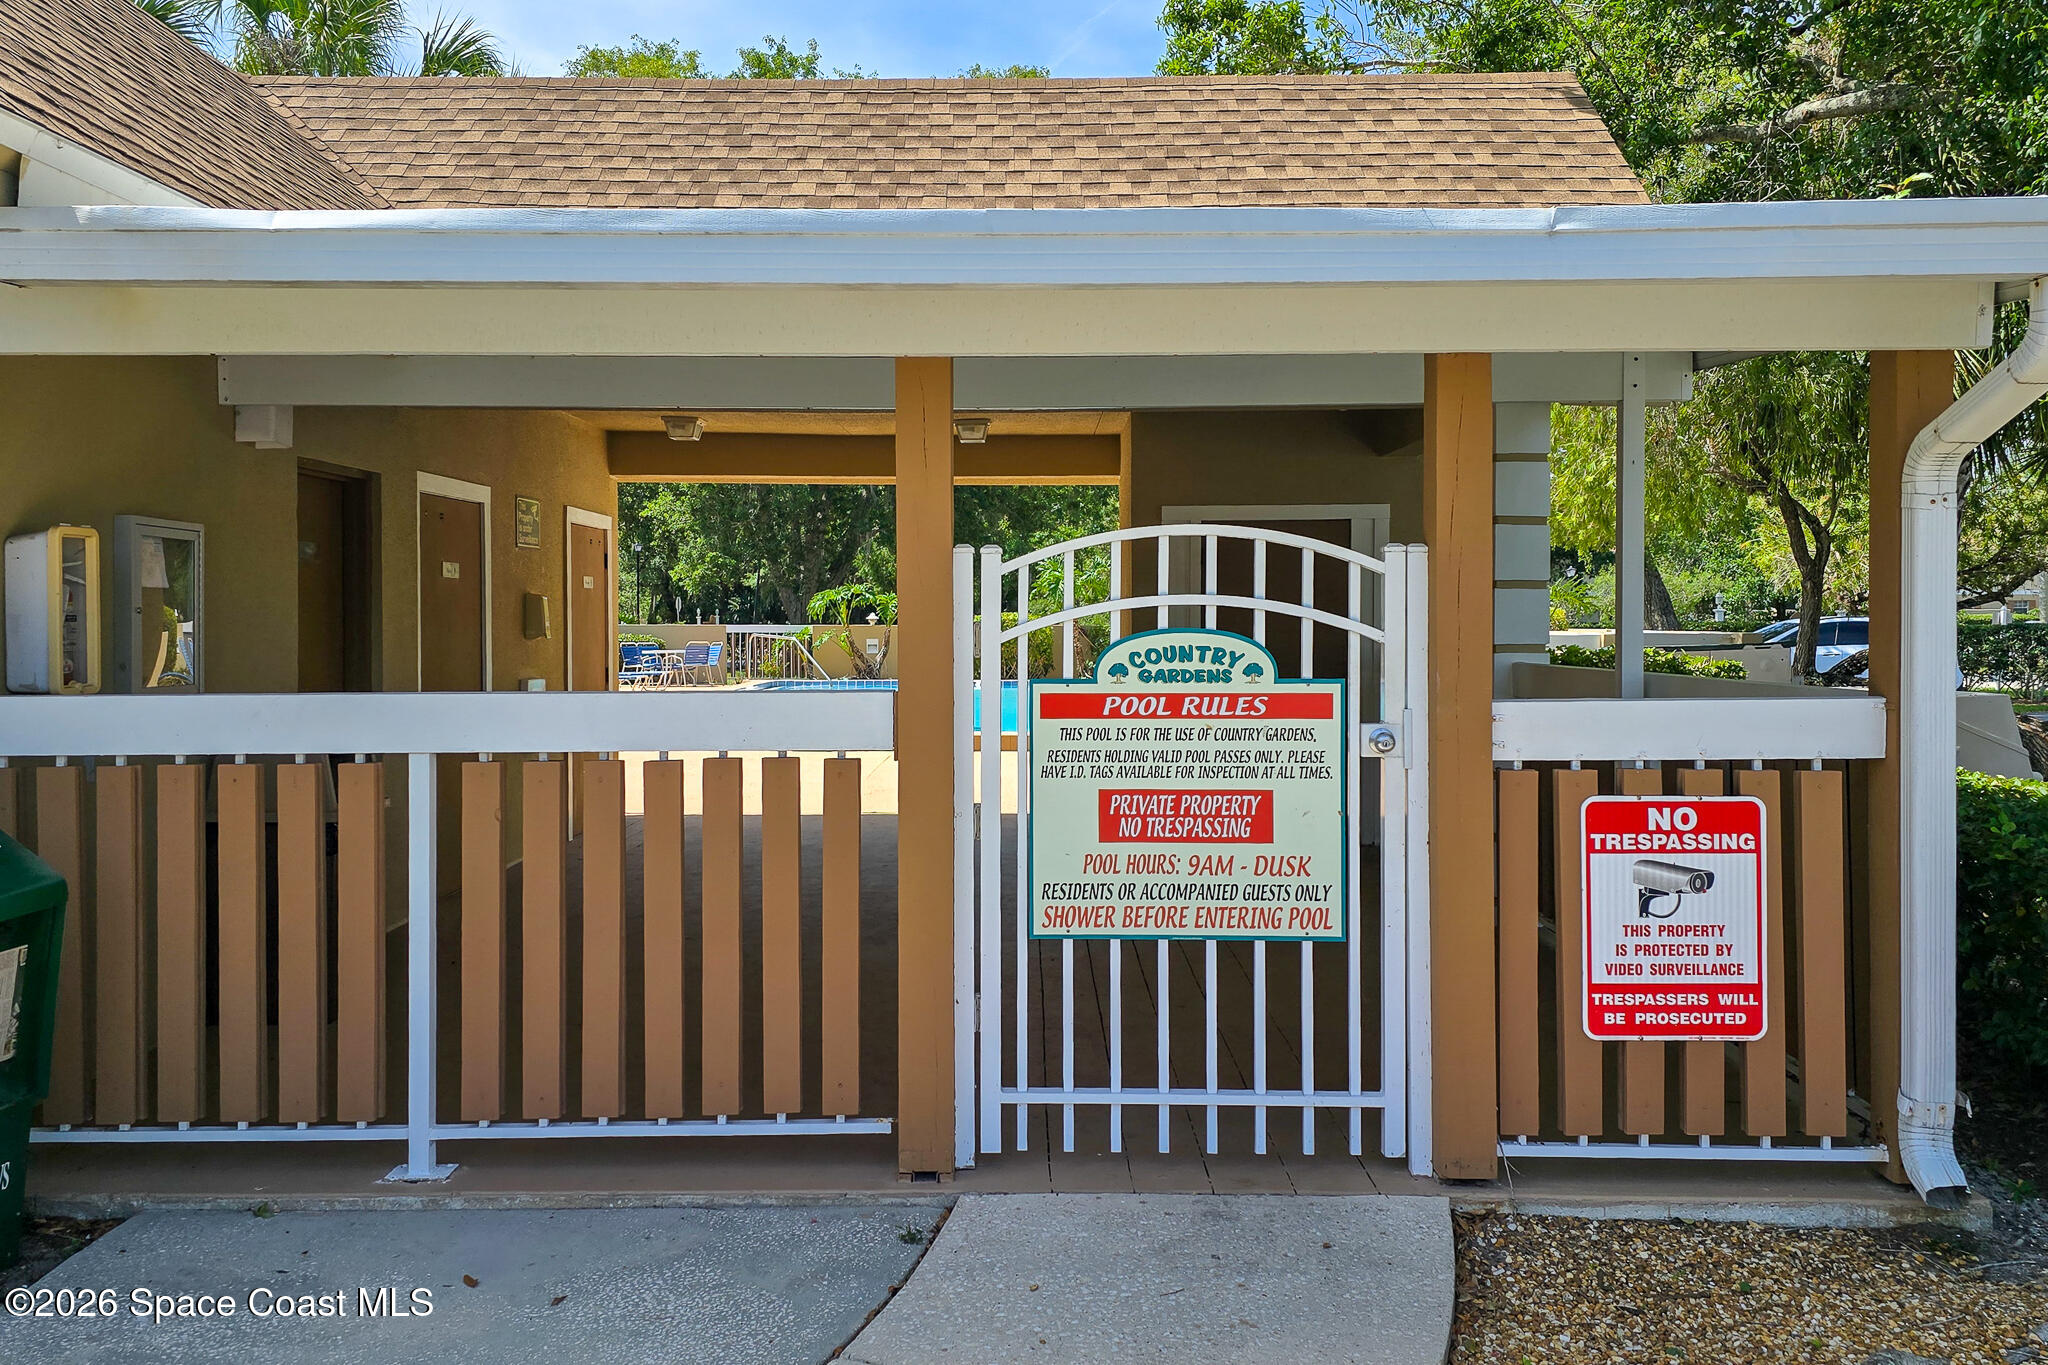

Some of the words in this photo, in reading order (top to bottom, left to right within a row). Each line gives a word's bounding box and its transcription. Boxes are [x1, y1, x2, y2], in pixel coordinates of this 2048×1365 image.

[1129, 645, 1245, 668] COUNTRY
[1138, 669, 1232, 683] GARDENS
[1103, 696, 1172, 716] POOL
[1181, 696, 1269, 716] RULES
[1060, 728, 1083, 741] THIS
[1086, 728, 1112, 741] POOL
[1115, 728, 1127, 741] IS
[1130, 728, 1150, 741] FOR
[1154, 728, 1172, 741] THE
[1175, 728, 1195, 741] USE
[1198, 728, 1211, 741] OF
[1214, 728, 1263, 741] COUNTRY
[1265, 728, 1317, 742] GARDENS.
[1047, 750, 1101, 763] RESIDENTS
[1104, 750, 1149, 763] HOLDING
[1152, 750, 1182, 763] VALID
[1185, 750, 1210, 763] POOL
[1214, 750, 1251, 763] PASSES
[1254, 750, 1284, 763] ONLY.
[1288, 750, 1326, 763] PLEASE
[1041, 765, 1067, 778] HAVE
[1070, 765, 1086, 778] I.D.
[1090, 765, 1114, 778] TAGS
[1116, 765, 1172, 778] AVAILABLE
[1175, 765, 1194, 778] FOR
[1198, 766, 1259, 779] INSPECTION
[1261, 766, 1275, 779] AT
[1277, 766, 1295, 779] ALL
[1299, 766, 1333, 779] TIMES.
[1110, 794, 1176, 815] PRIVATE
[1179, 794, 1261, 816] PROPERTY
[1648, 807, 1698, 831] NO
[1119, 817, 1142, 838] NO
[1146, 817, 1252, 838] TRESPASSING
[1590, 833, 1756, 850] TRESPASSING
[1083, 853, 1120, 874] POOL
[1126, 853, 1181, 875] HOURS:
[1188, 854, 1234, 876] 9AM
[1253, 855, 1312, 877] DUSK
[1042, 883, 1114, 900] RESIDENTS
[1118, 883, 1136, 900] OR
[1140, 883, 1239, 901] ACCOMPANIED
[1243, 884, 1291, 901] GUESTS
[1295, 885, 1333, 902] ONLY
[1042, 905, 1116, 928] SHOWER
[1122, 905, 1189, 929] BEFORE
[1194, 906, 1283, 929] ENTERING
[1288, 907, 1333, 930] POOL
[1623, 924, 1651, 937] THIS
[1658, 924, 1725, 937] PROPERTY
[1616, 943, 1627, 957] IS
[1635, 943, 1709, 957] PROTECTED
[1716, 943, 1734, 957] BY
[1605, 963, 1643, 976] VIDEO
[1650, 963, 1744, 976] SURVEILLANCE
[1592, 993, 1709, 1006] TRESPASSERS
[1718, 993, 1759, 1006] WILL
[1604, 1012, 1626, 1025] BE
[1635, 1012, 1747, 1025] PROSECUTED
